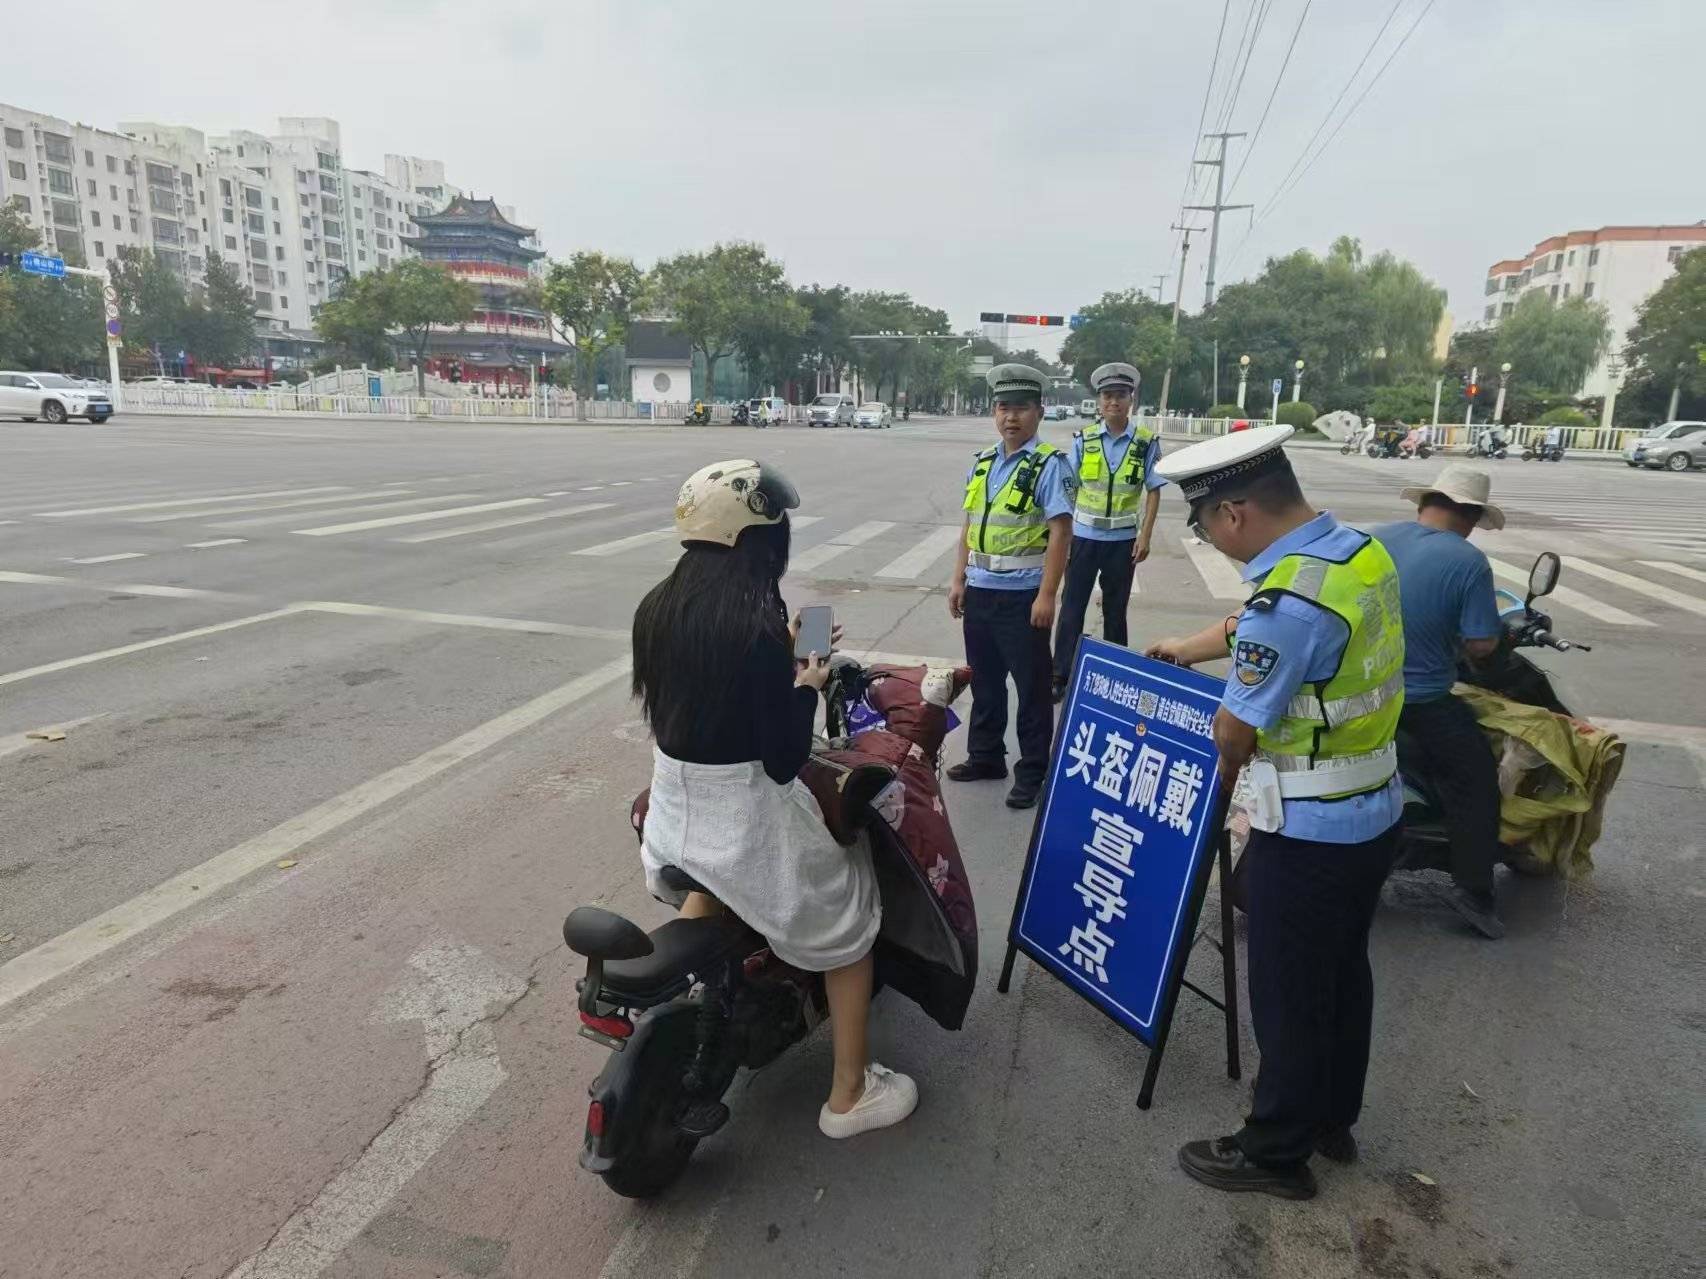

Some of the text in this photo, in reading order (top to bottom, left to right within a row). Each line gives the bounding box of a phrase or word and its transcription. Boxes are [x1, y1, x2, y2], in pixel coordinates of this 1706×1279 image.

[1066, 721, 1203, 836] 头盔佩戴
[1058, 808, 1145, 983] 宣导点
